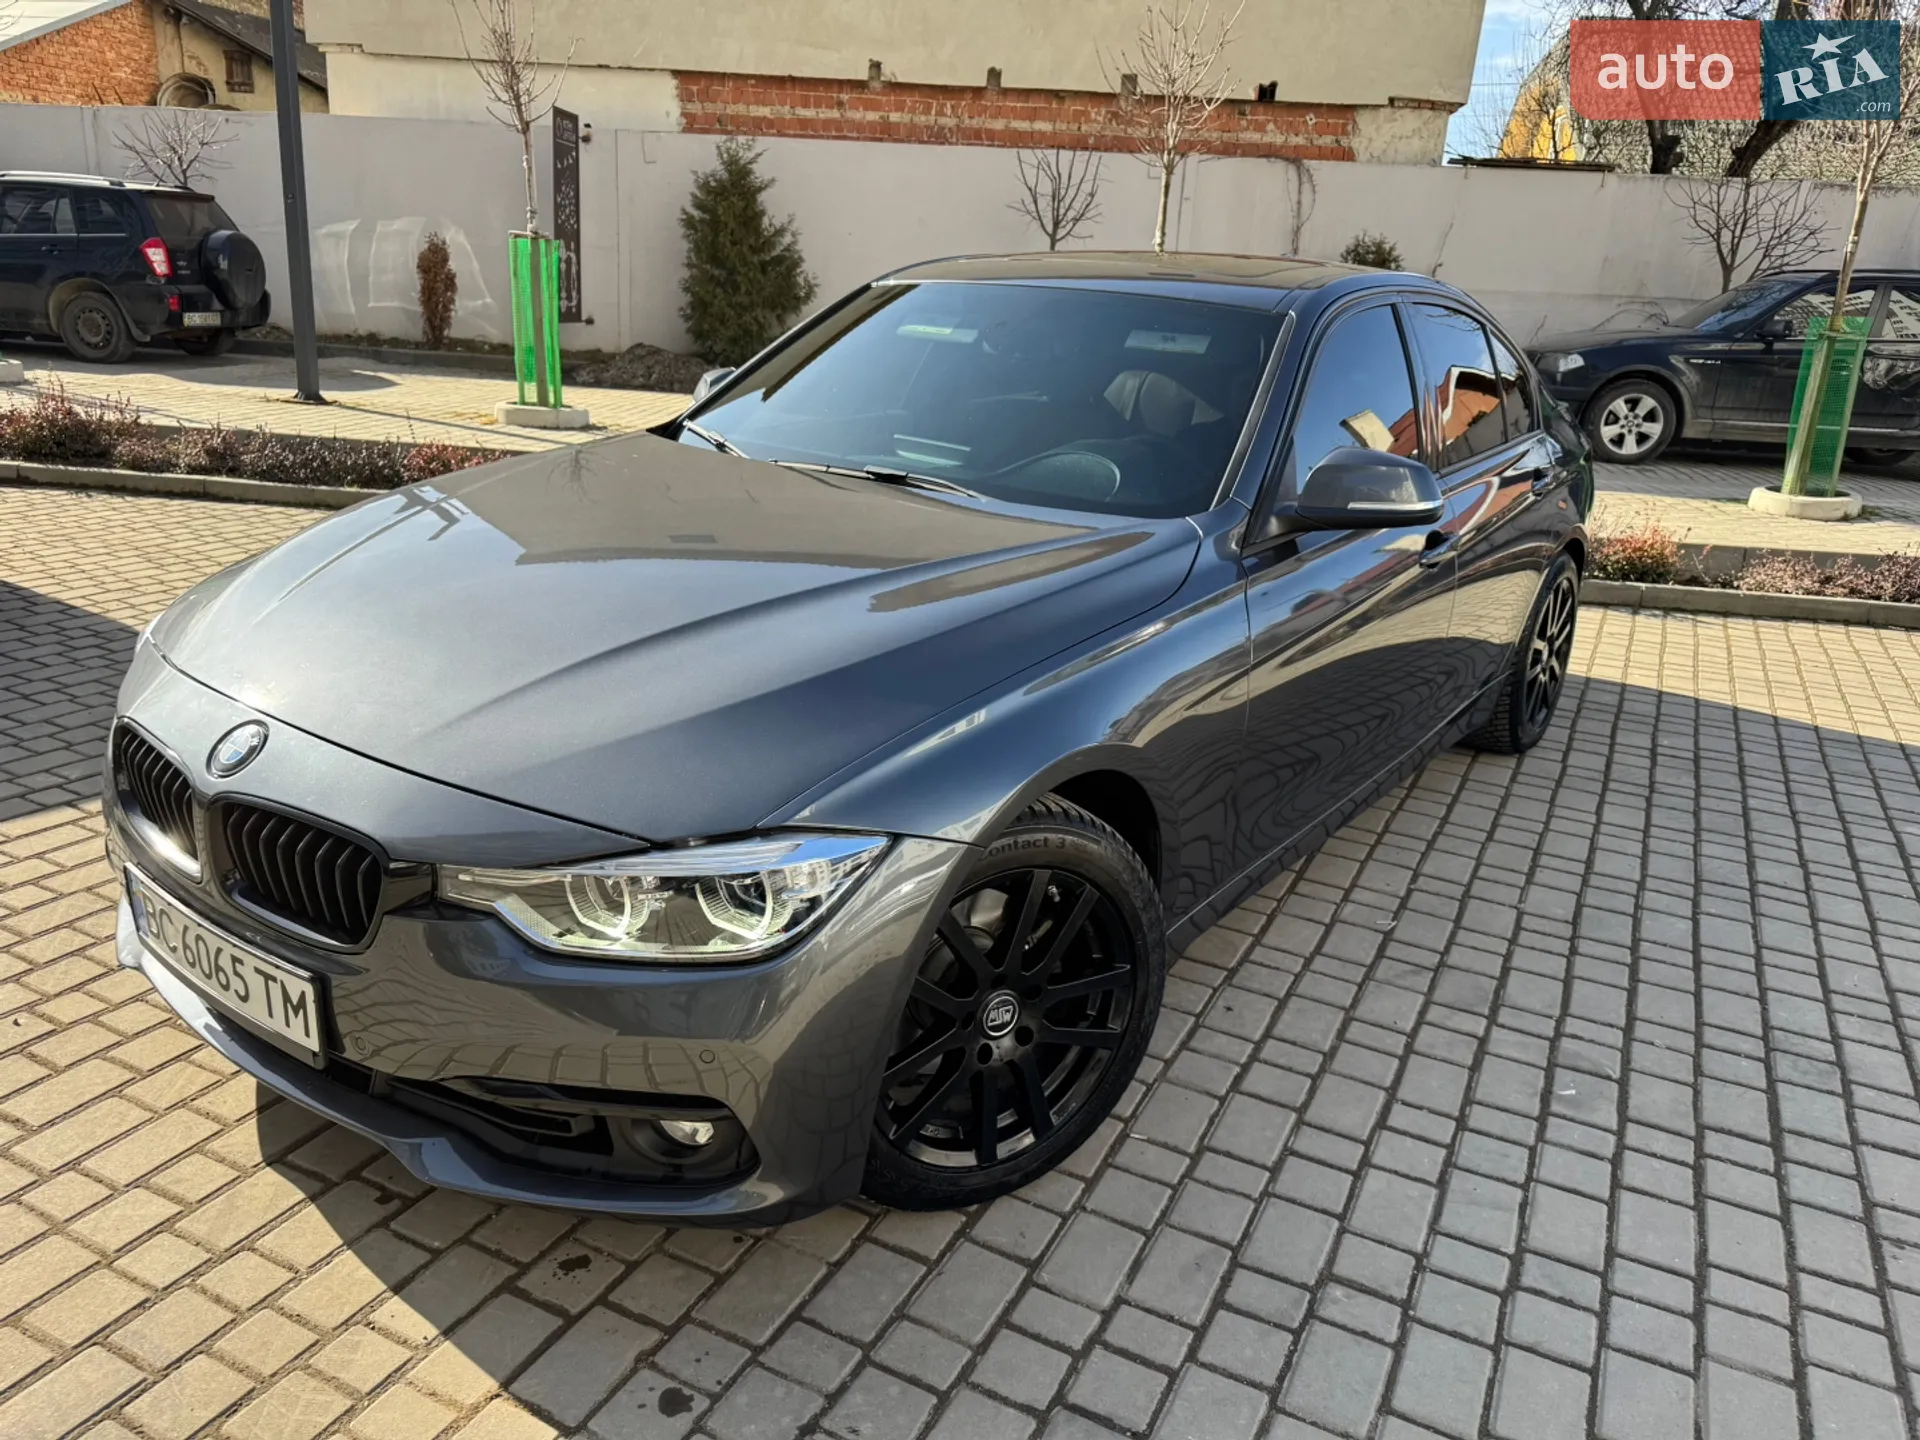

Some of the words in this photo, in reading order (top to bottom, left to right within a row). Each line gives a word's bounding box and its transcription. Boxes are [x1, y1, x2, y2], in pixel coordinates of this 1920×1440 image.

[1055, 837, 1066, 849] 3
[143, 891, 178, 954] BC
[181, 924, 250, 1004] 6065
[253, 965, 311, 1039] TM
[987, 1005, 1014, 1027] MSW
